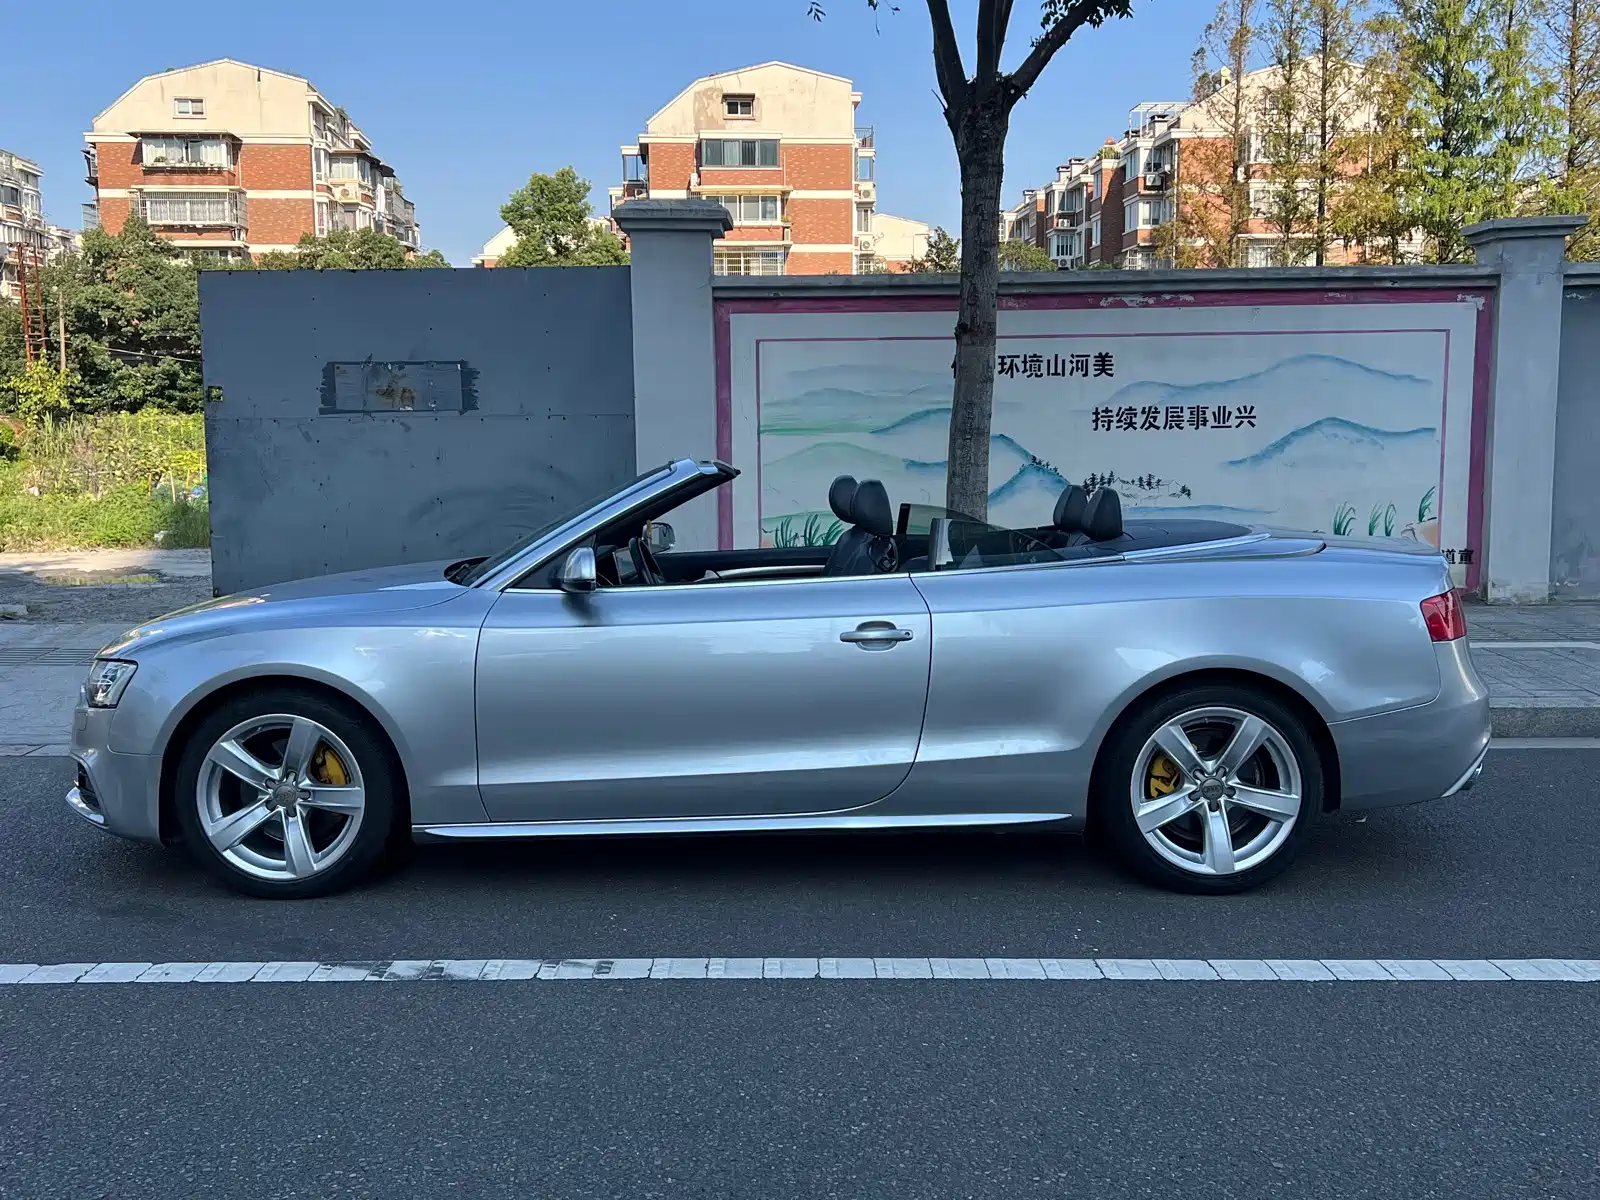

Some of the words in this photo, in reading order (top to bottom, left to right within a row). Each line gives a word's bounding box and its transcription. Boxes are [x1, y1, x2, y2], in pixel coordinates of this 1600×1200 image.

[951, 352, 1115, 378] 环境山河美
[1092, 405, 1257, 431] 持续发展事业兴
